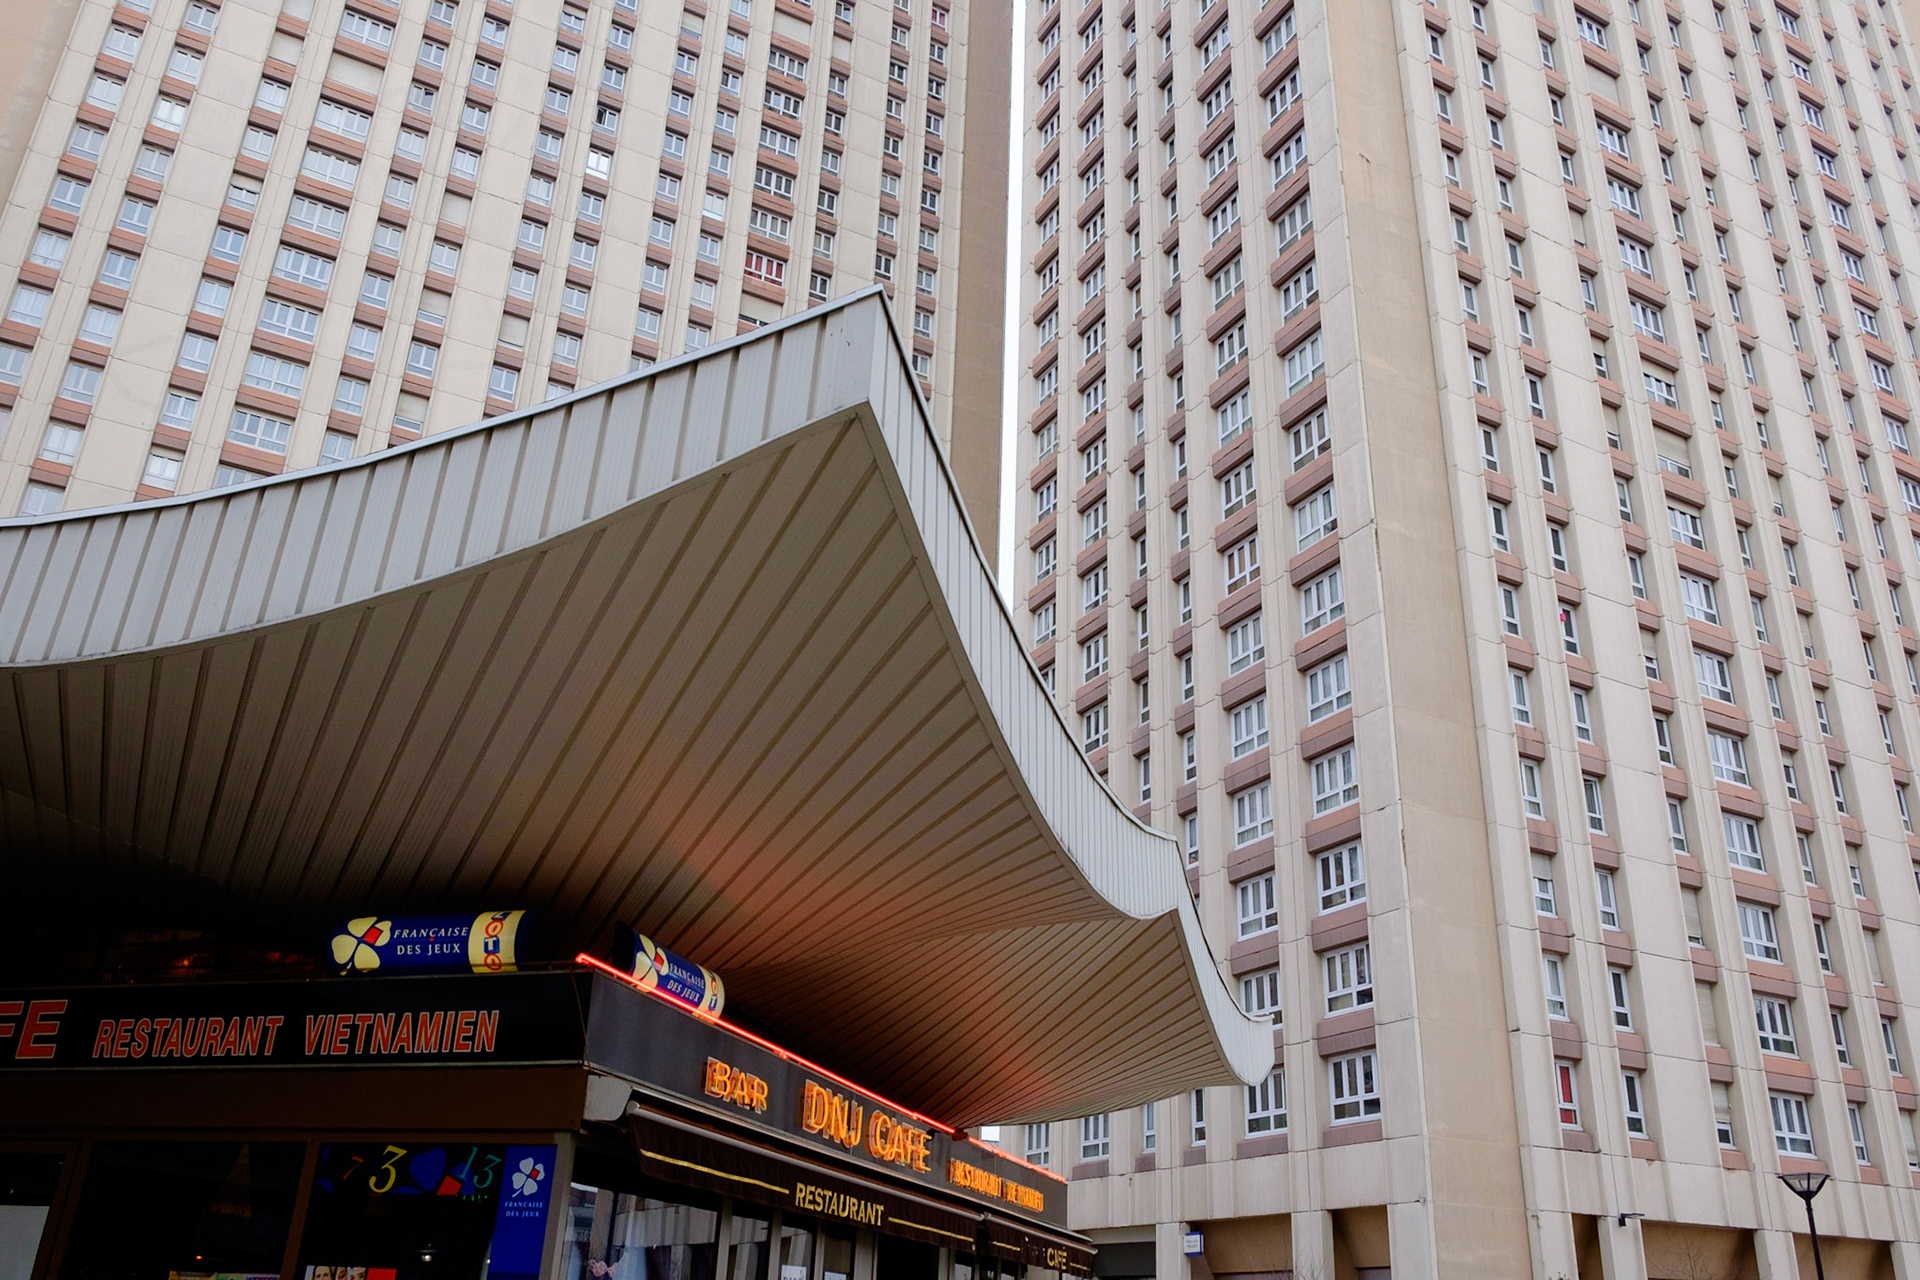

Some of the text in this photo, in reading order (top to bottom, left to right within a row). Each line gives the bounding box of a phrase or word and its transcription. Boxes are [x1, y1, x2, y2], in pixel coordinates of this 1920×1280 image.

[393, 926, 469, 942] FRANÇAISE
[396, 943, 461, 956] DES JEUX
[669, 962, 705, 989] FRANÇAISE
[667, 979, 701, 1003] DES JEUX
[93, 1015, 285, 1058] RESTAURANT
[304, 1010, 500, 1056] VIETNAMIEN
[705, 1056, 769, 1115] BAR
[803, 1078, 864, 1149] DNJ
[868, 1110, 933, 1174] CAFE
[369, 1144, 408, 1194] 3
[521, 1210, 541, 1219] JEUX
[795, 1182, 884, 1227] RESTAURANT
